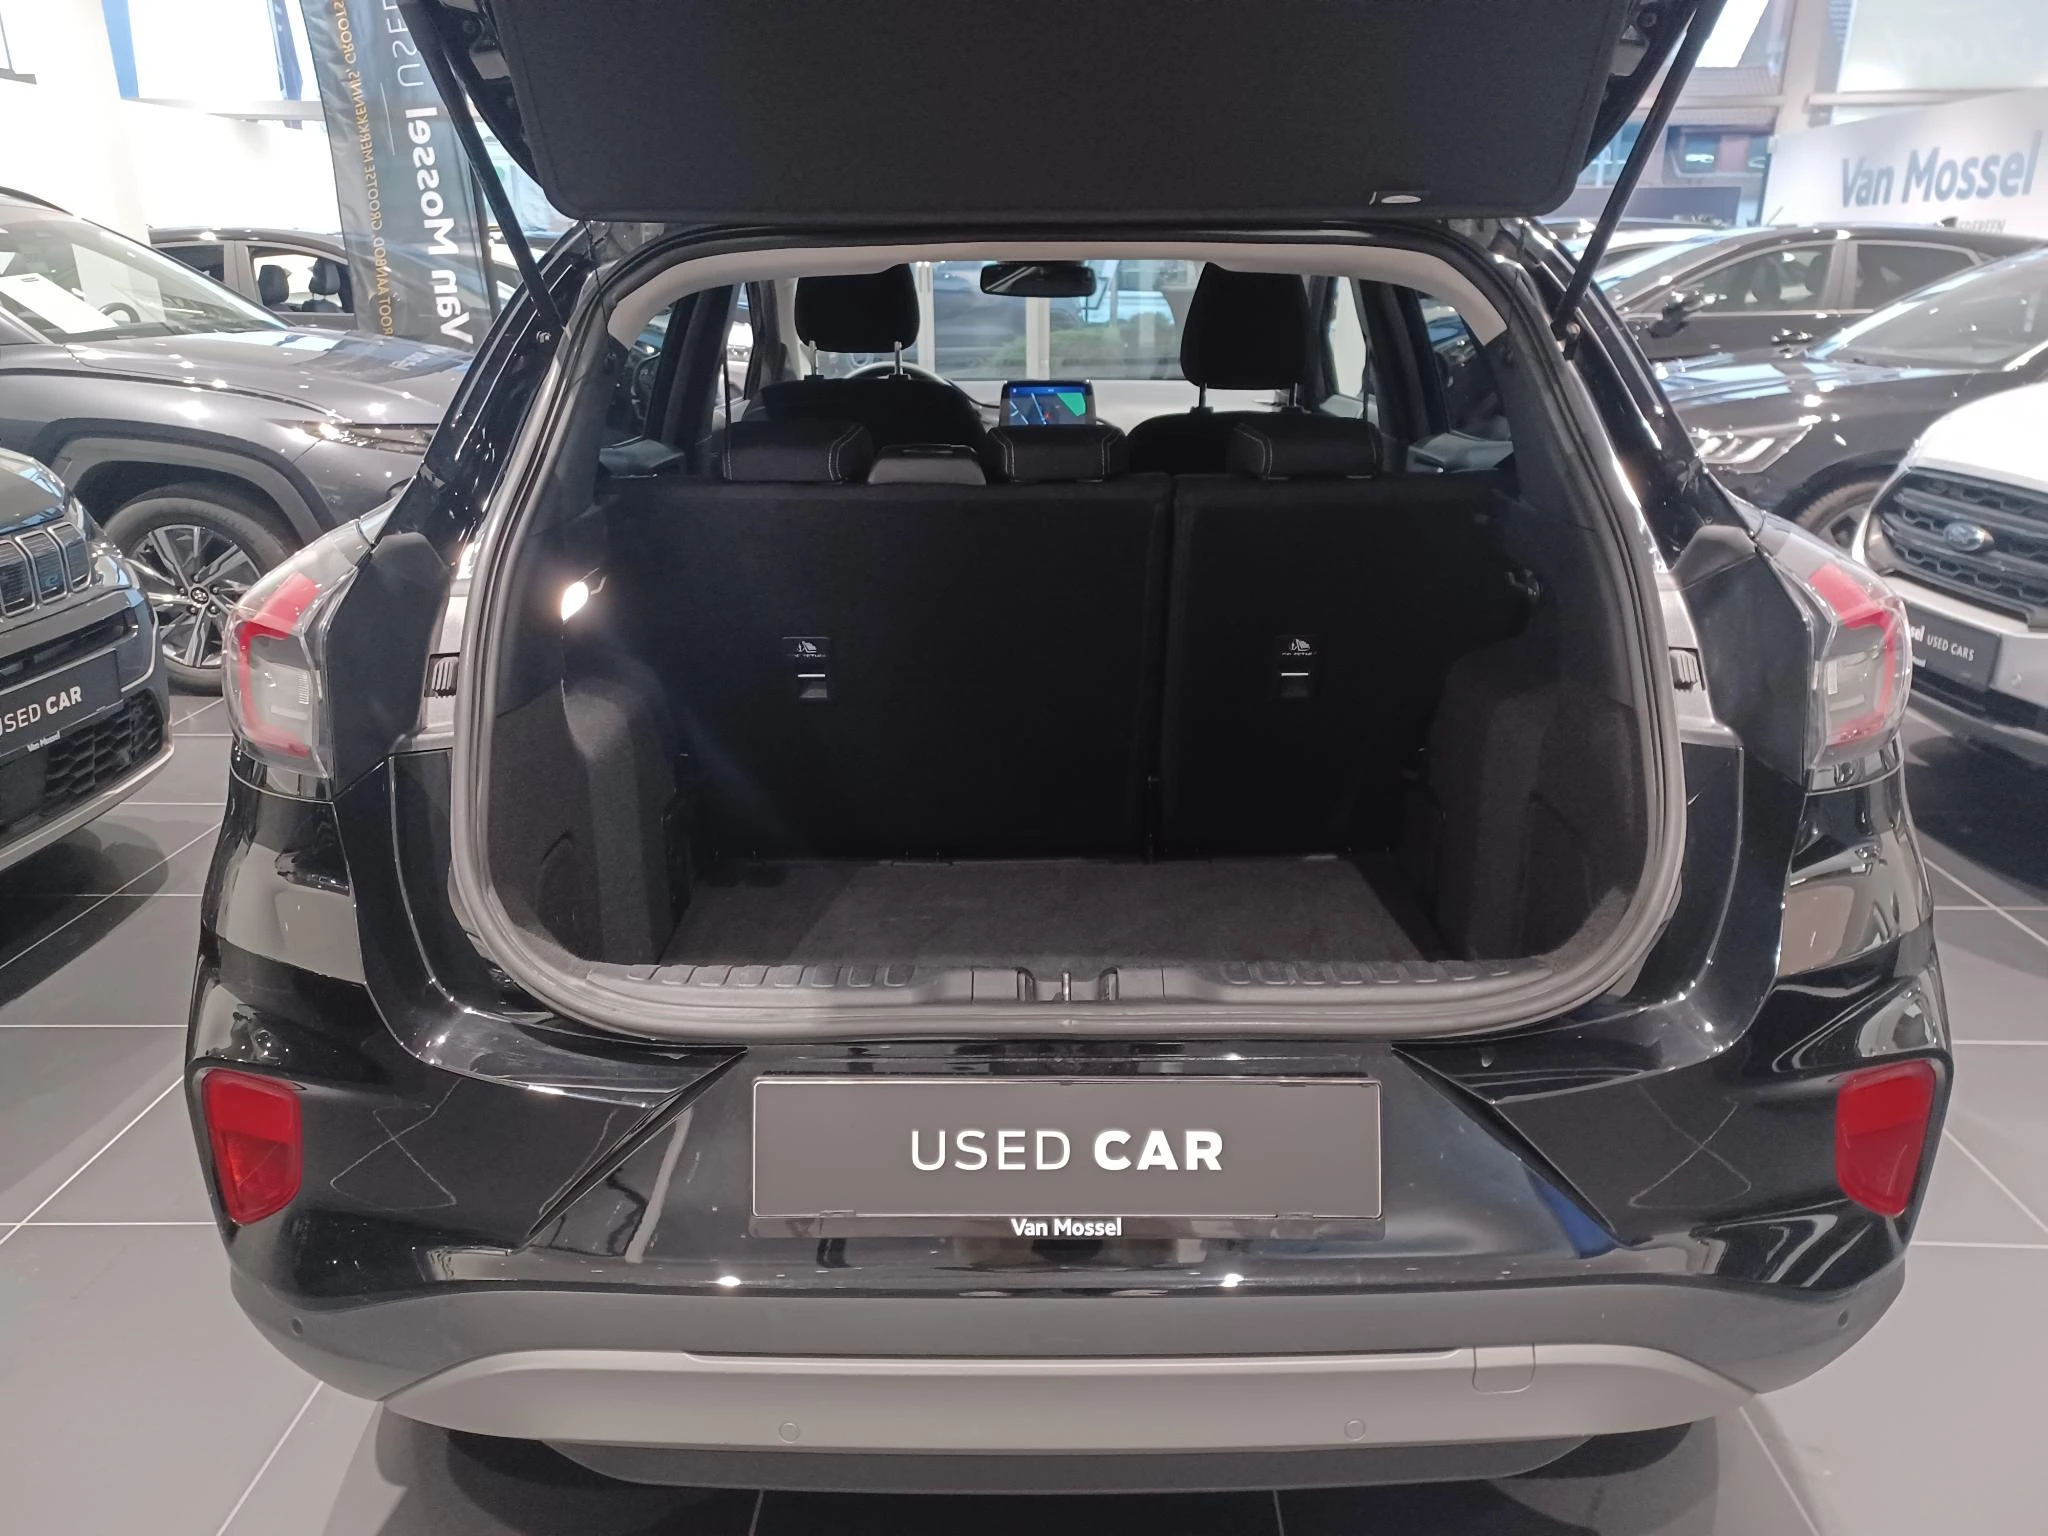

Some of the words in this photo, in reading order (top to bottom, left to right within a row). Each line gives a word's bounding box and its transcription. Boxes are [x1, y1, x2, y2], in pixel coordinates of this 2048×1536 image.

[1842, 157, 1894, 208] Van
[1901, 130, 2043, 204] Mossel
[1911, 625, 1925, 642] sel
[1927, 634, 1949, 651] USED
[1951, 643, 1975, 661] CARS
[46, 686, 82, 714] CAR
[911, 1130, 1070, 1171] USED
[1093, 1130, 1223, 1171] CAR
[1010, 1218, 1048, 1236] Van
[1054, 1217, 1122, 1236] Mossel
